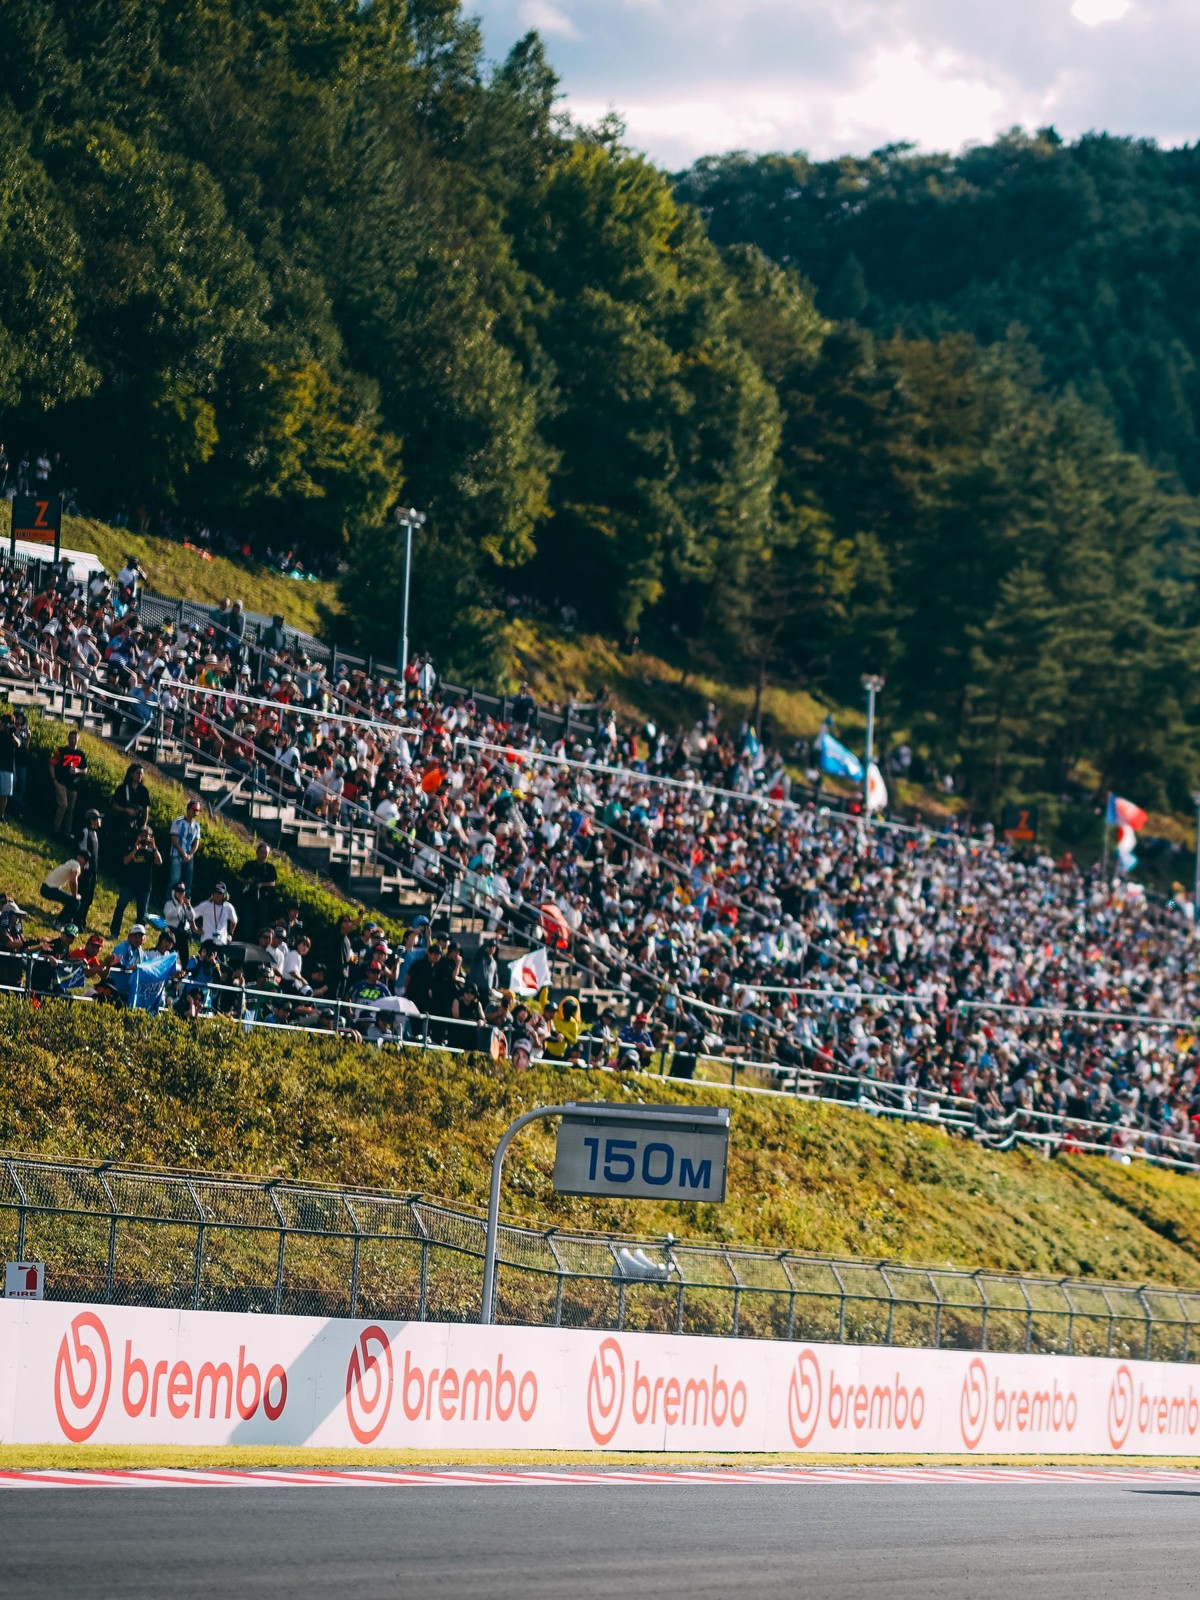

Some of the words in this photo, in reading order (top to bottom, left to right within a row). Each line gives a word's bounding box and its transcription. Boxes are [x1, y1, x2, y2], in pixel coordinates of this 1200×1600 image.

[34, 501, 49, 527] Z
[358, 988, 381, 1001] 46
[584, 1137, 712, 1189] 150M
[123, 1340, 287, 1421] brembo
[404, 1350, 538, 1422] brembo
[632, 1360, 748, 1428] brembo
[828, 1369, 925, 1430] brembo
[994, 1377, 1077, 1433] brembo
